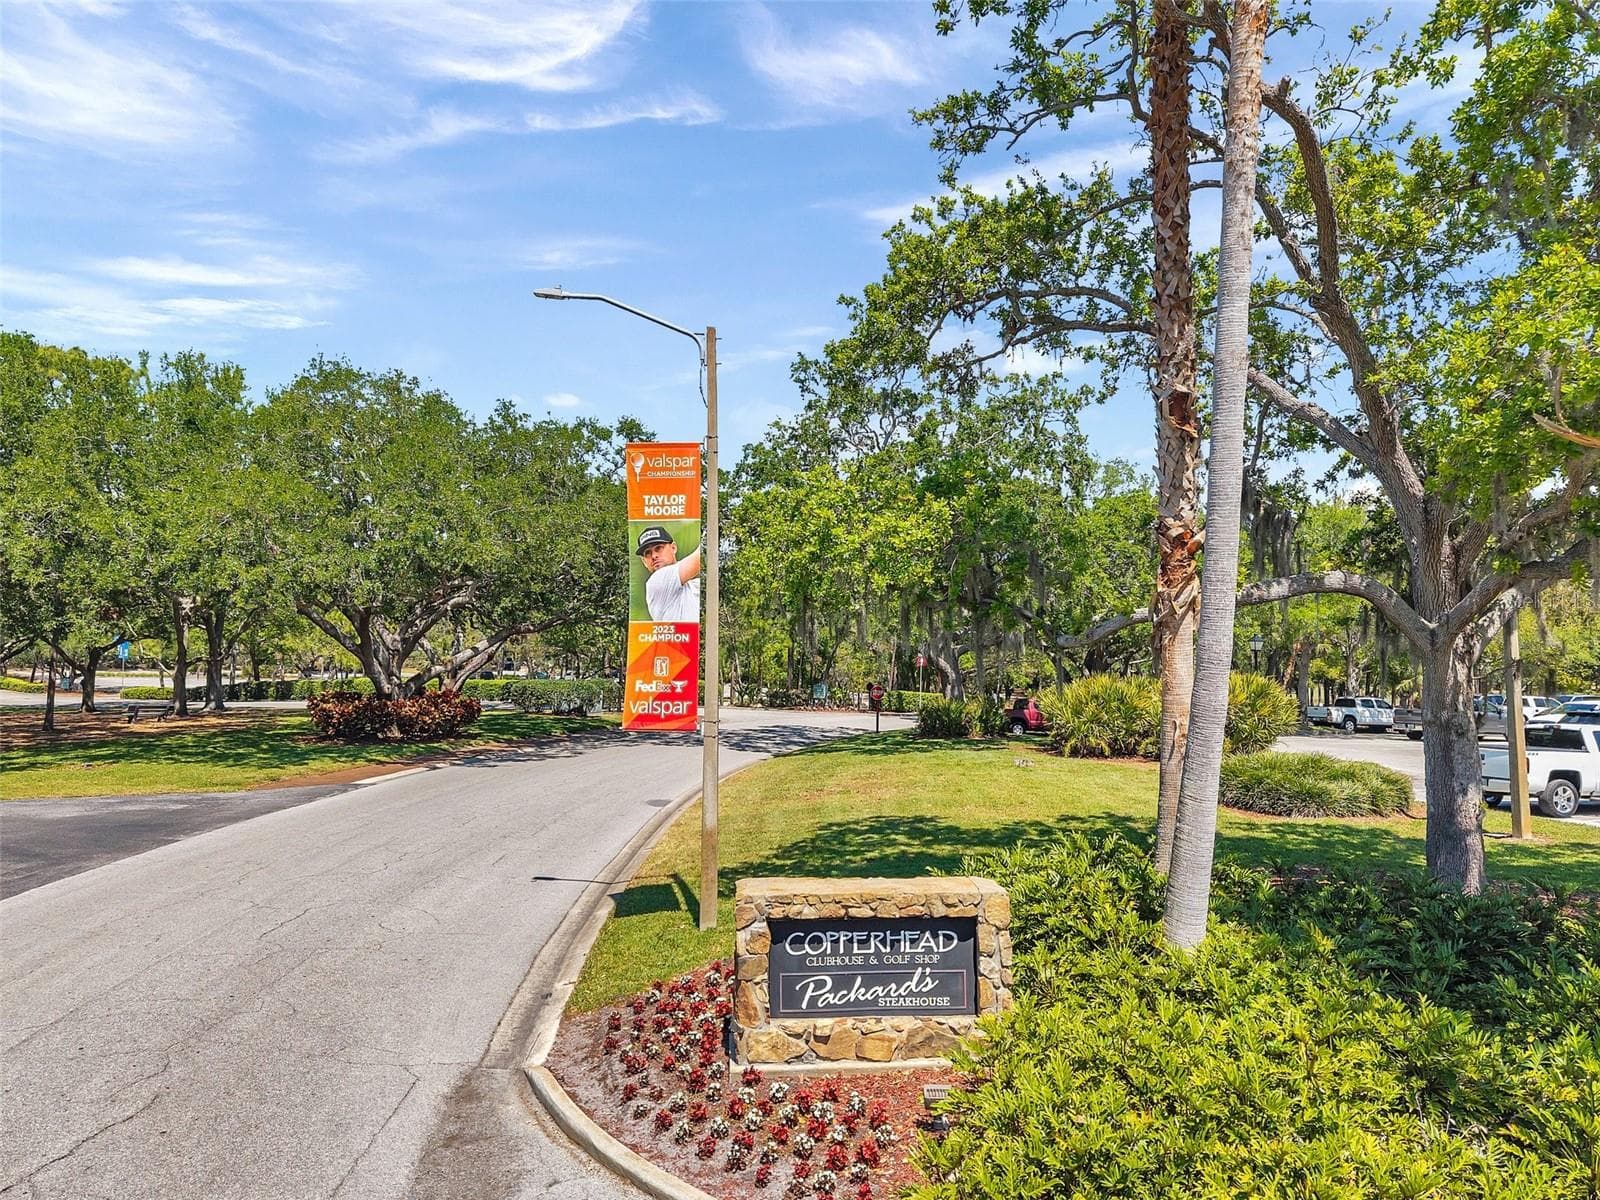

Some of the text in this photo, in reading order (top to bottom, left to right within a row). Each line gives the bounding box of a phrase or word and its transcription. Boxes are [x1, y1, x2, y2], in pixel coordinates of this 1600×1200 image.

[646, 454, 697, 470] valspar
[643, 495, 686, 505] TAYLOR
[644, 506, 685, 516] MOORE
[652, 625, 675, 634] 2023
[638, 634, 690, 642] CHAMPION
[634, 680, 671, 692] FedEx
[629, 696, 693, 718] valspar
[785, 930, 958, 956] COPPERHEAD
[806, 955, 940, 966] CLUBHOUSE & GOLF SHOP
[795, 967, 940, 1010] Packard's
[878, 997, 950, 1007] STEAKHOUSE
